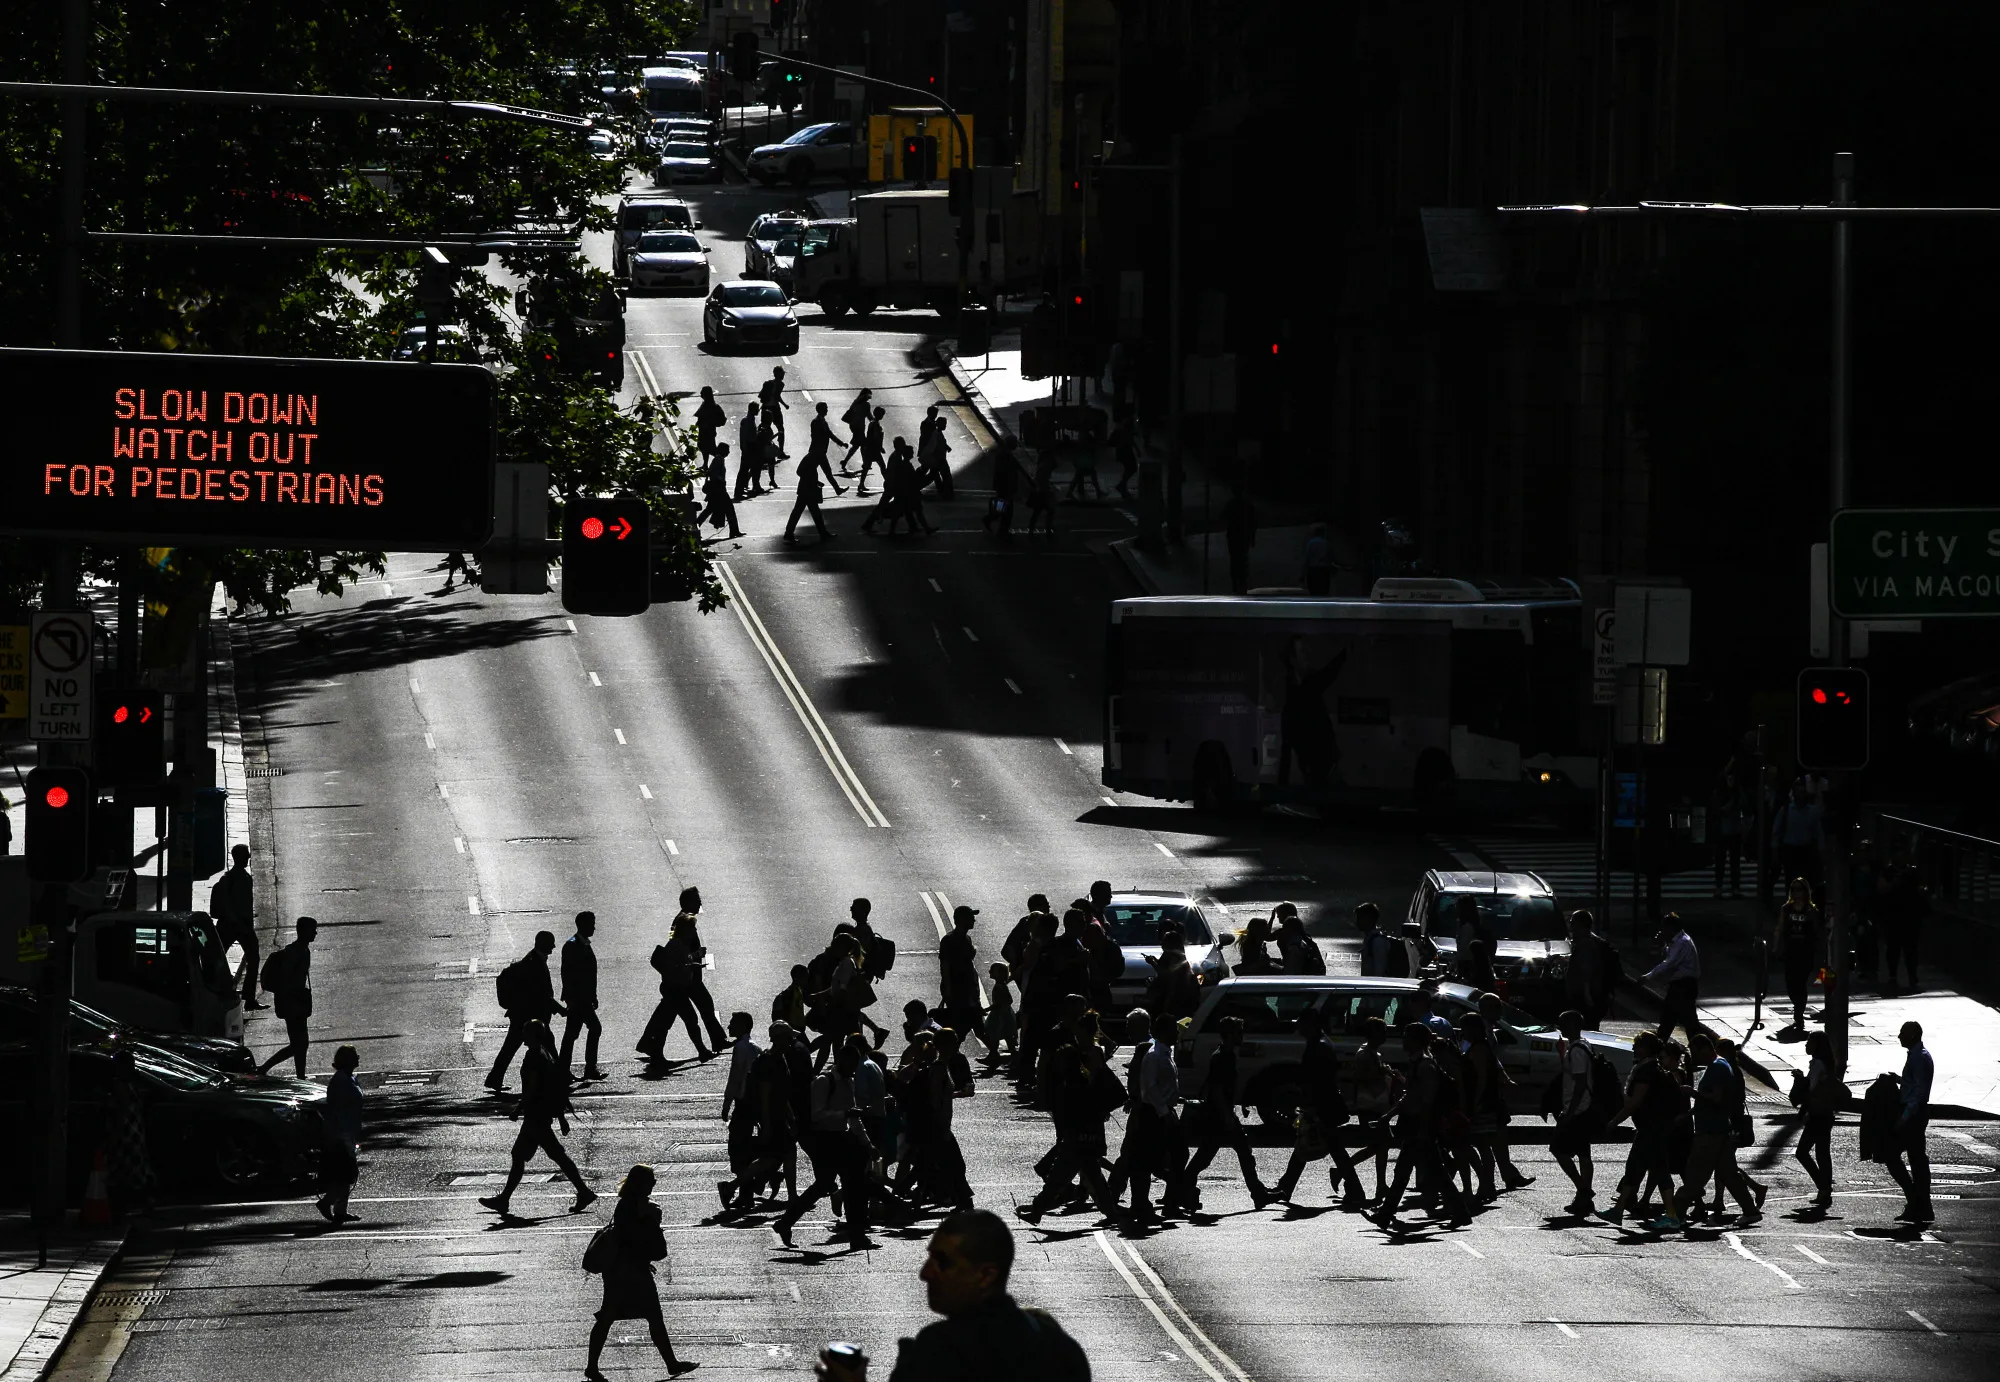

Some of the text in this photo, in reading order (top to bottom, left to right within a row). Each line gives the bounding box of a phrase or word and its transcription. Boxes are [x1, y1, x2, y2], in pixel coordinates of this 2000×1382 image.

[115, 387, 318, 426] SLOW DOWN
[113, 426, 319, 465] WATCH OUT
[44, 463, 384, 506] FOR PEDESTRIANS
[1872, 529, 1958, 564] City
[1852, 575, 1899, 598] VIA
[45, 679, 78, 697] NO
[40, 703, 80, 716] LEFT
[39, 721, 81, 735] TURN
